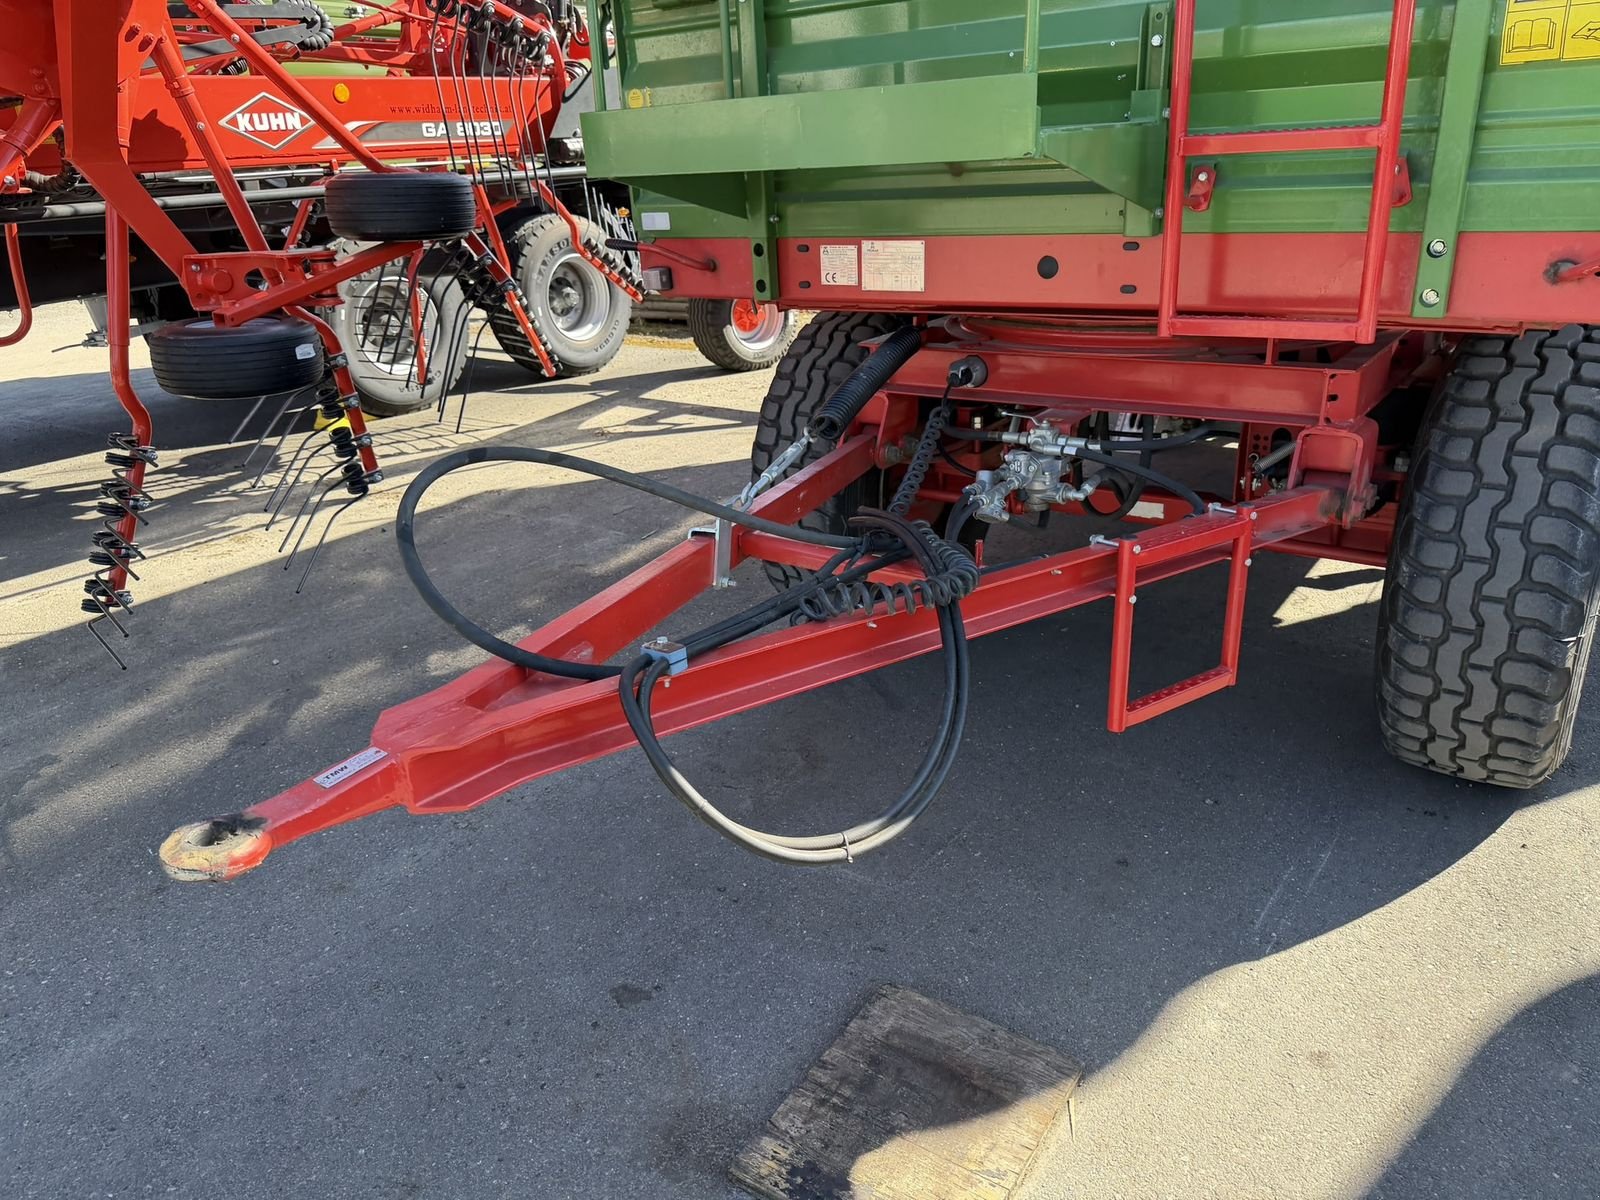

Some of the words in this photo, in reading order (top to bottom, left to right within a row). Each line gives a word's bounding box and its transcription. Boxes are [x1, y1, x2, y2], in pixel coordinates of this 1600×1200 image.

[236, 112, 302, 132] KUHN
[421, 122, 451, 137] GA
[456, 121, 503, 136] 8030
[532, 238, 568, 284] SAMSO
